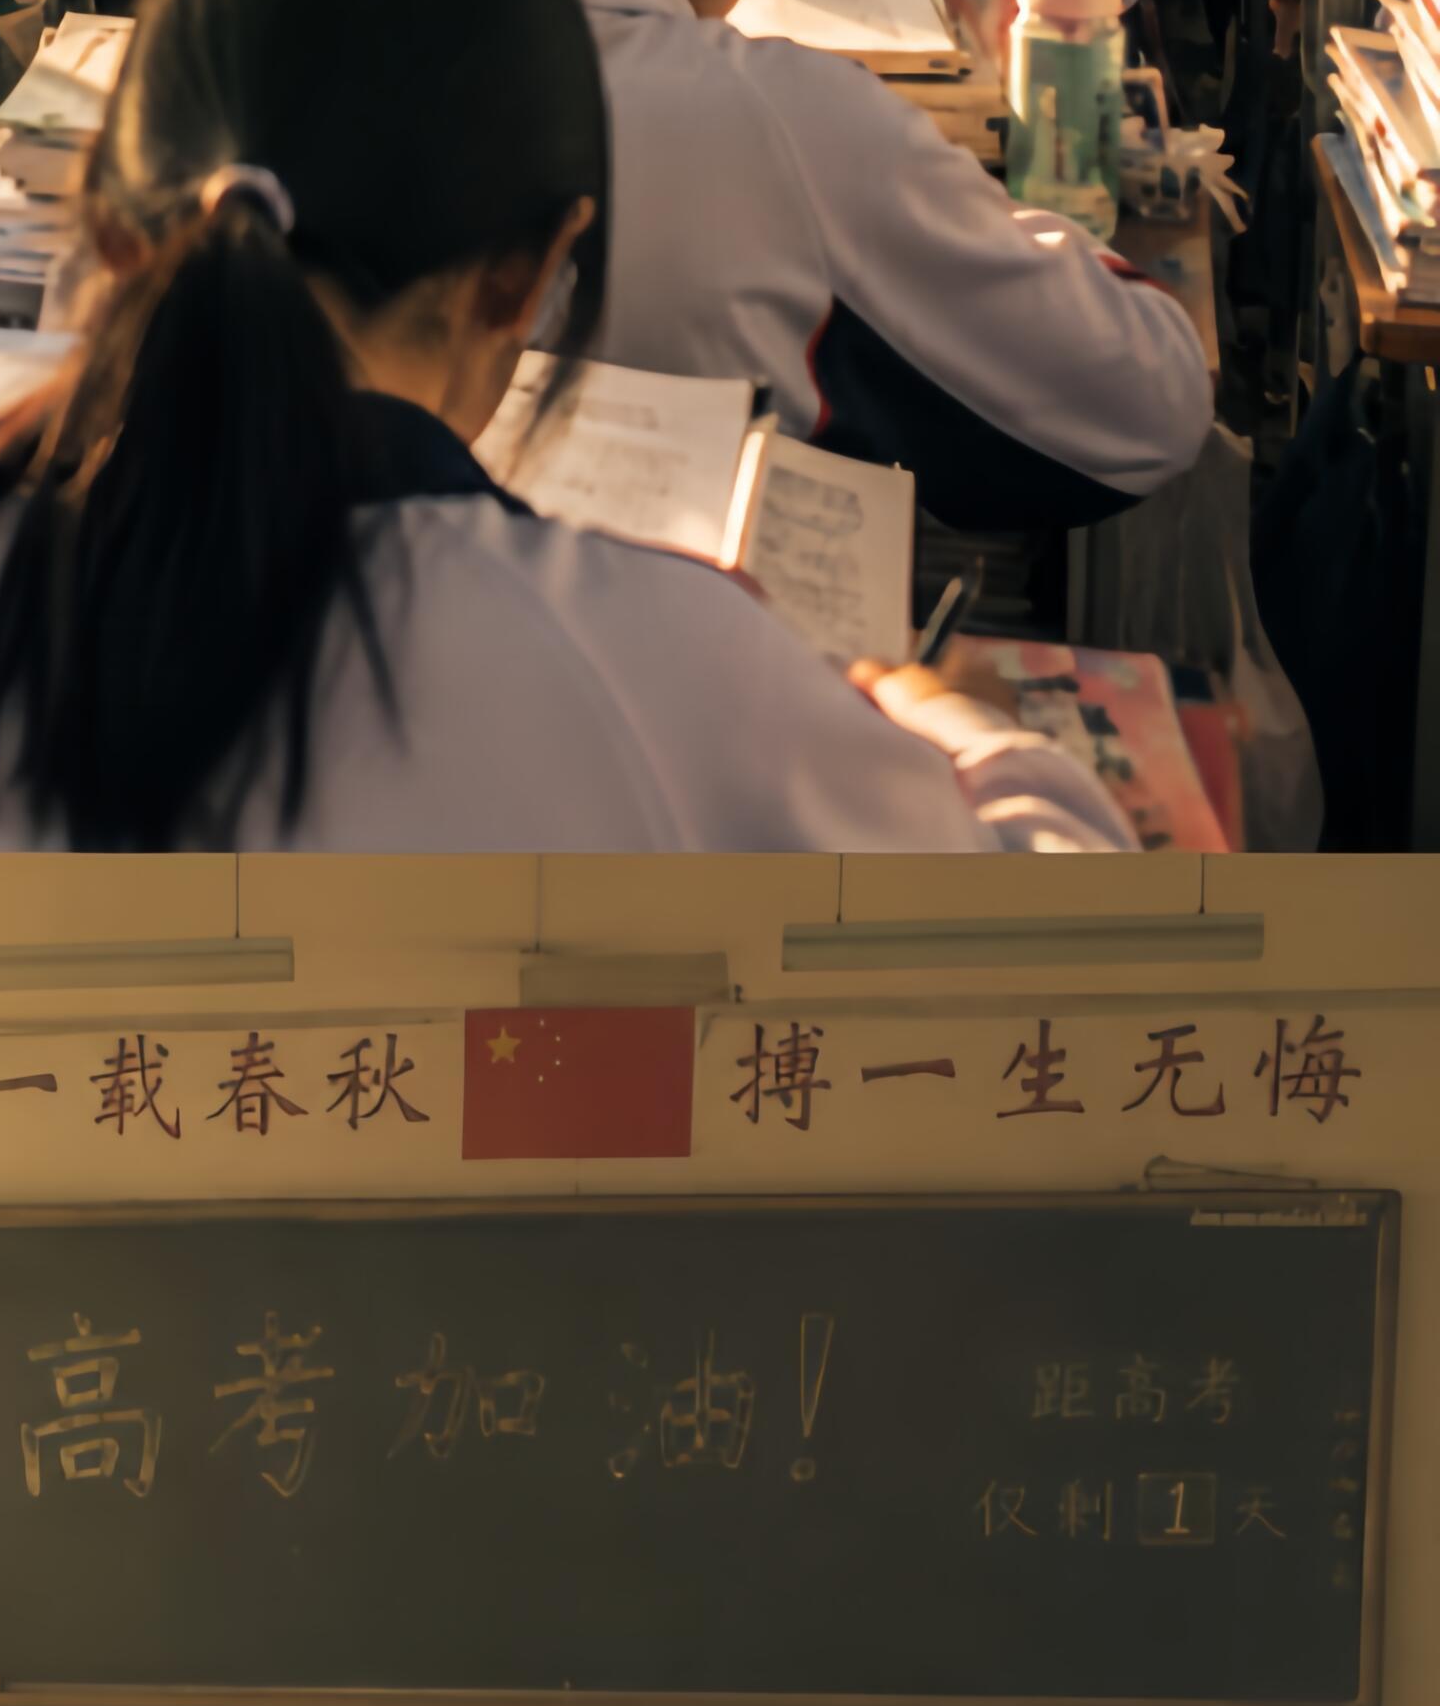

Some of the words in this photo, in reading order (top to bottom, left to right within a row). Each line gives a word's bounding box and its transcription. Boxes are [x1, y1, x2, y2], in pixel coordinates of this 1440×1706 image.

[729, 1014, 1362, 1132] 搏一生无悔
[20, 1310, 836, 1499] 高考加油!
[1031, 1353, 1242, 1425] 距高考
